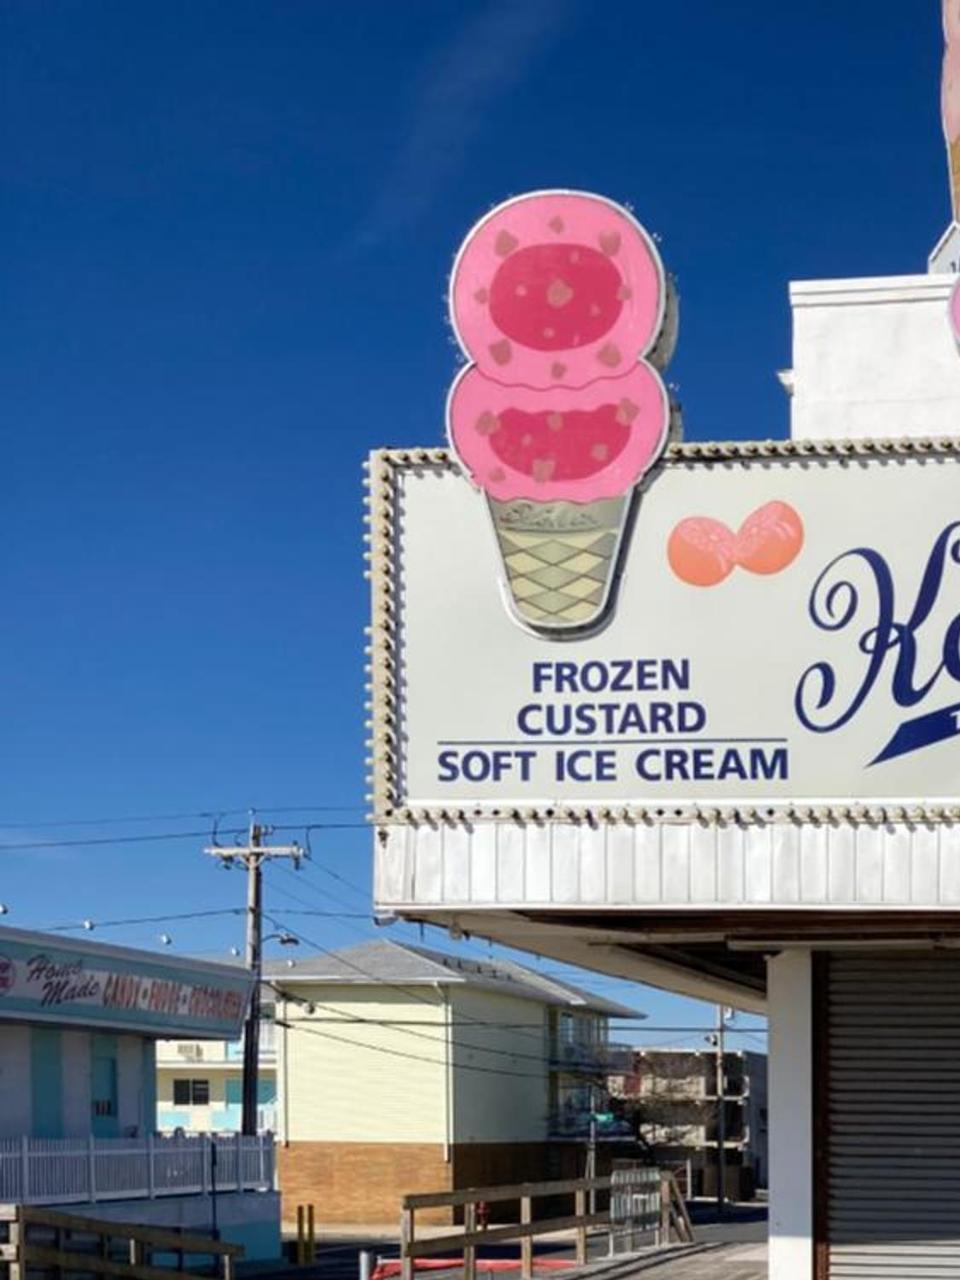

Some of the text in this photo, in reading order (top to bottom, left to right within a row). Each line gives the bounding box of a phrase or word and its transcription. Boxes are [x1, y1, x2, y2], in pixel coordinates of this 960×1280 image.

[532, 659, 690, 693] FROZEN
[517, 701, 707, 735] CUSTARD
[437, 748, 789, 782] SOFT ICE CREAM
[26, 954, 82, 983] Home
[41, 974, 99, 1007] Made
